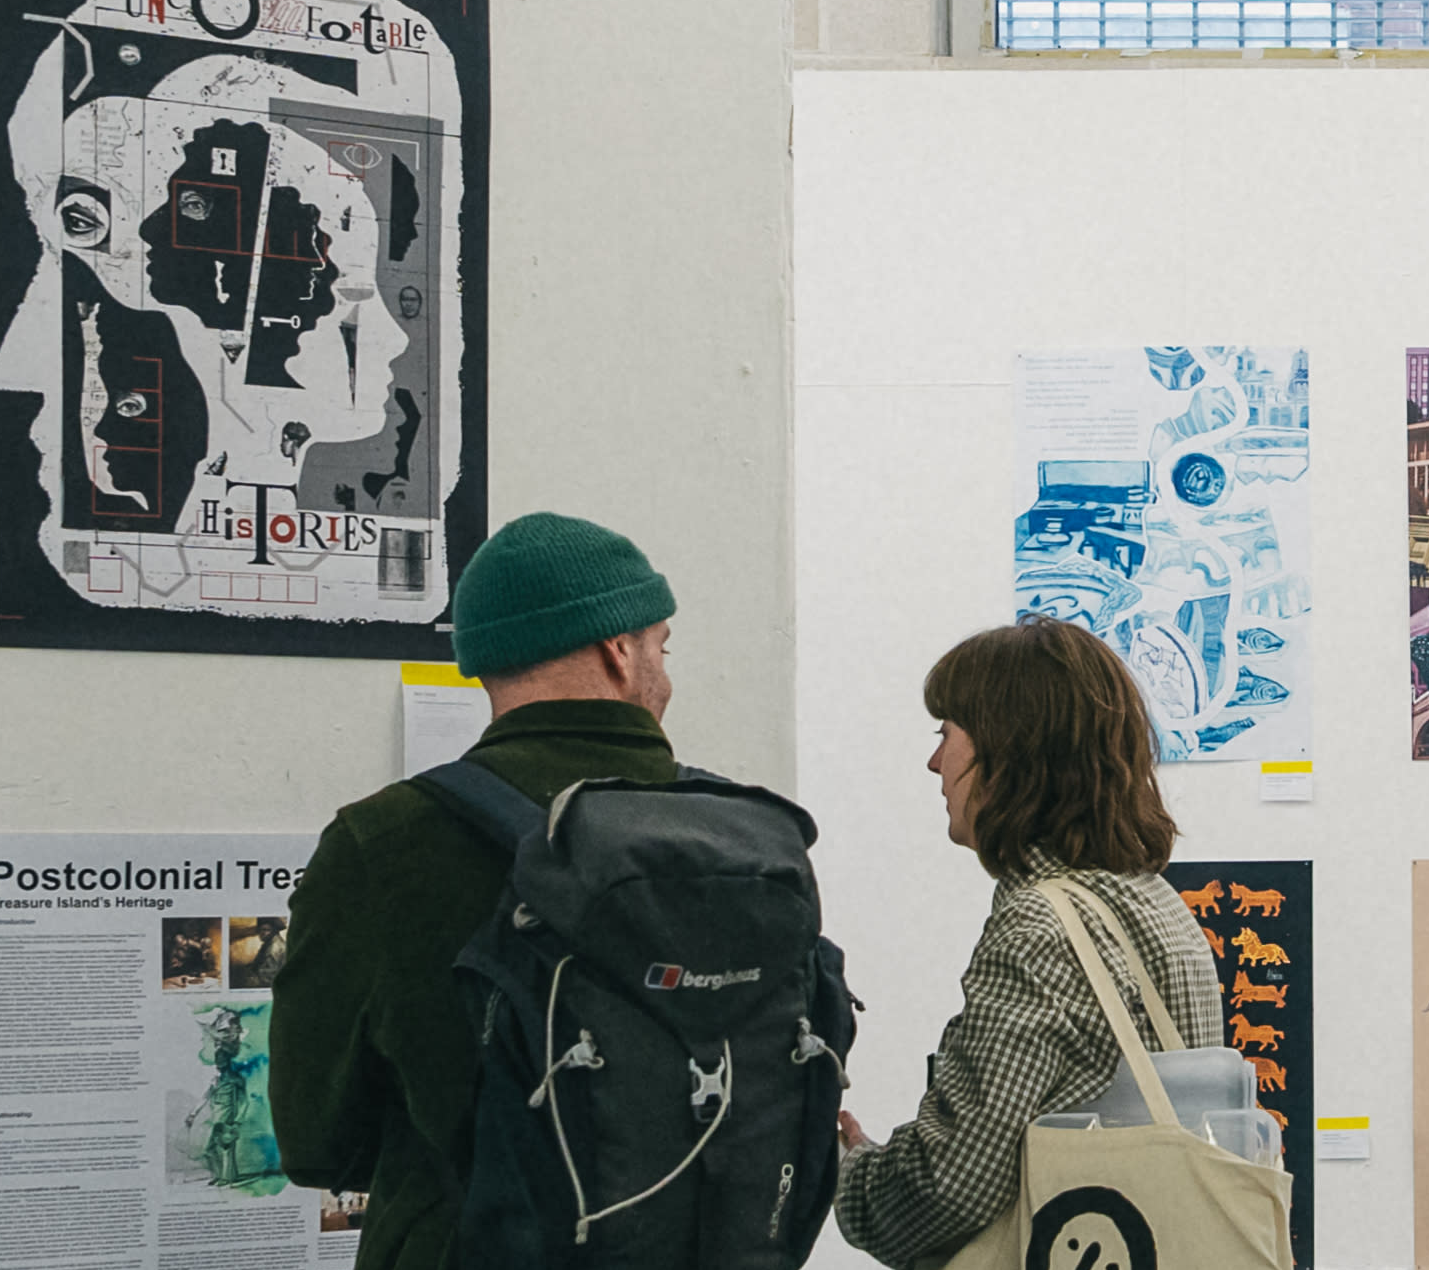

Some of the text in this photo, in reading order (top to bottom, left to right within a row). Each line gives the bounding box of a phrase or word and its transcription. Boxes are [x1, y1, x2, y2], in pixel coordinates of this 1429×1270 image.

[57, 896, 111, 908] Island's
[115, 897, 174, 910] Heritage
[682, 966, 762, 991] berghaus
